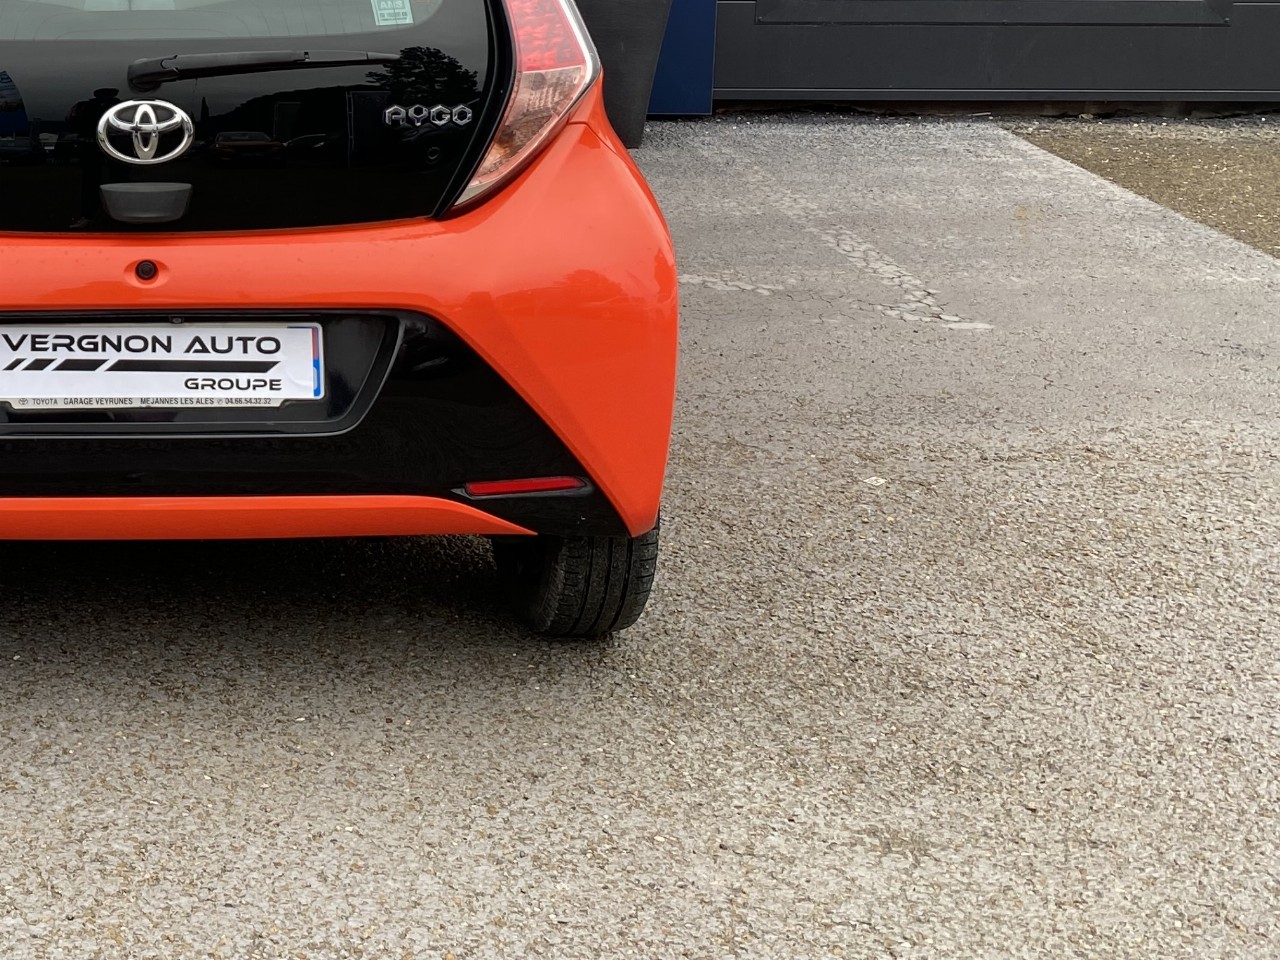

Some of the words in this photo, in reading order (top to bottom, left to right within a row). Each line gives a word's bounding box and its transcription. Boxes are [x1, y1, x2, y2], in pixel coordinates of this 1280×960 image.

[380, 0, 403, 10] ANS
[385, 104, 472, 127] AYGO
[1, 333, 172, 354] VERGNON
[183, 335, 282, 355] AUTO
[184, 377, 282, 391] GROUPE
[32, 398, 58, 406] TOYOTA
[63, 397, 93, 406] GARAGE
[95, 397, 133, 406] VEYRUNES
[140, 397, 179, 405] MEJANNES
[180, 397, 194, 405] LES
[195, 397, 214, 405] ALES
